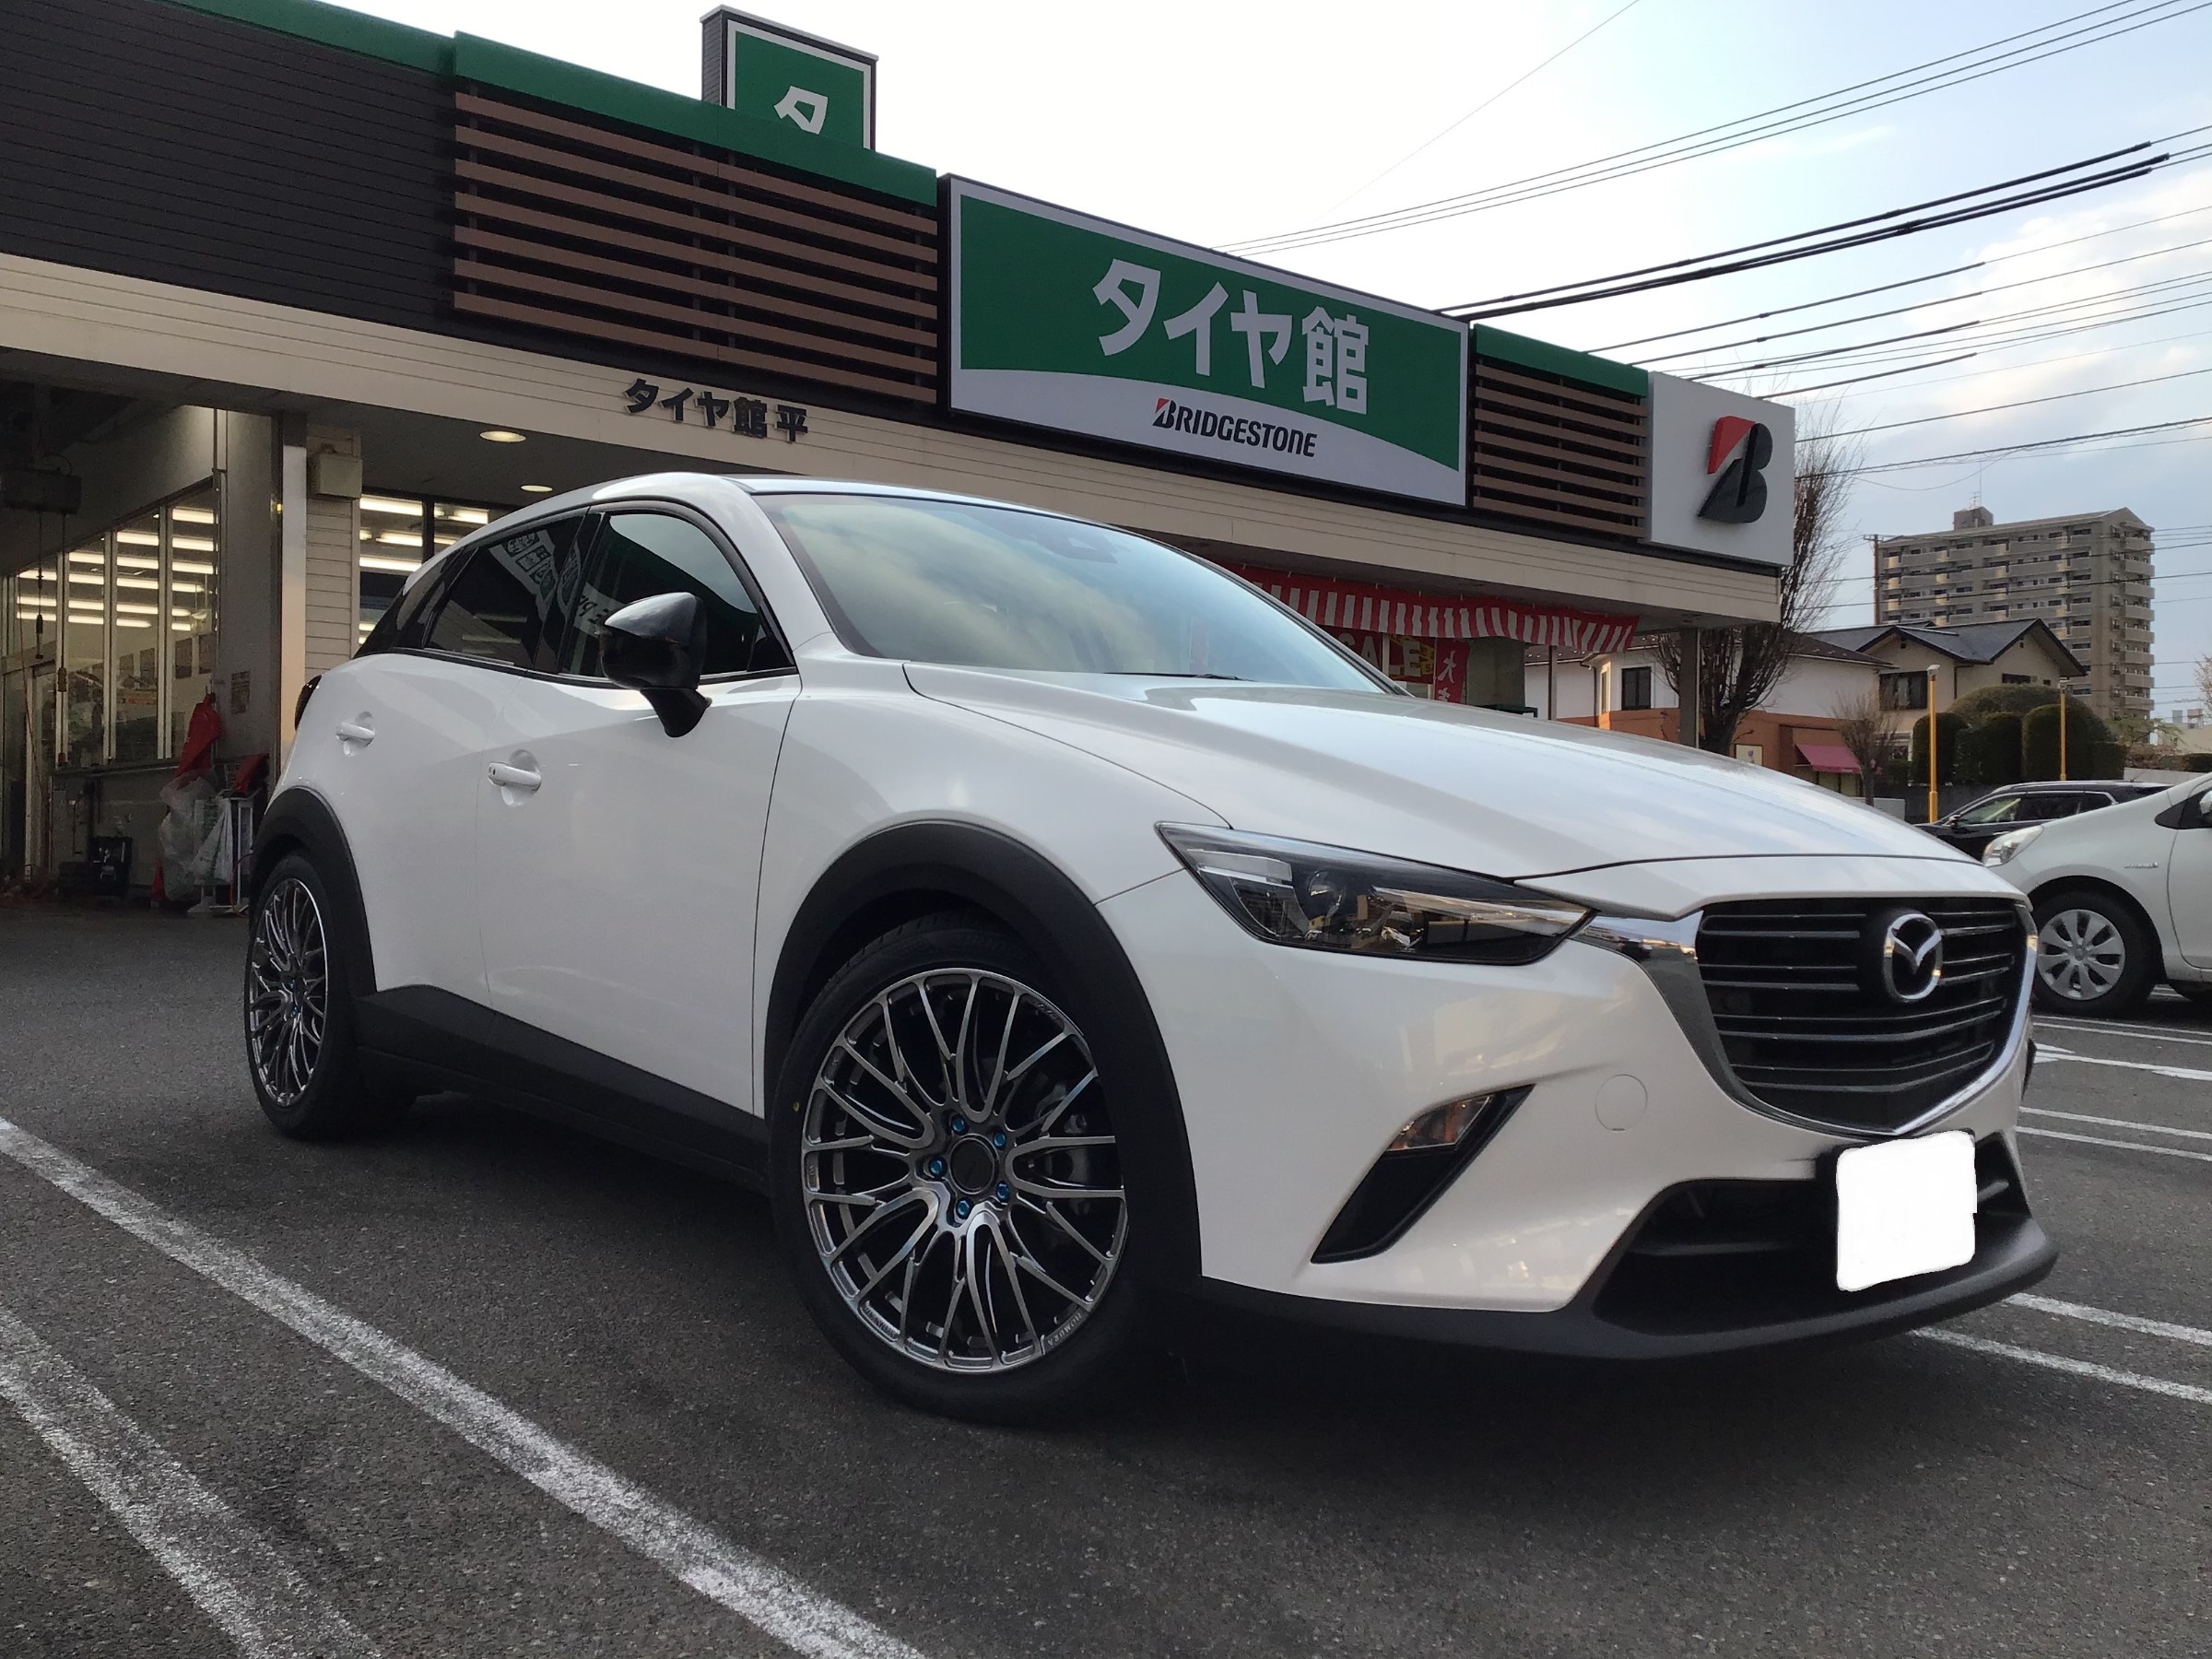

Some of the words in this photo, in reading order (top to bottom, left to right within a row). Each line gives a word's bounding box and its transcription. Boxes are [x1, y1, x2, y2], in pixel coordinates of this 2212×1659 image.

[1092, 258, 1370, 415] タイヤ館
[1151, 397, 1318, 458] BRIDGESTONE
[1337, 633, 1421, 677] AE
